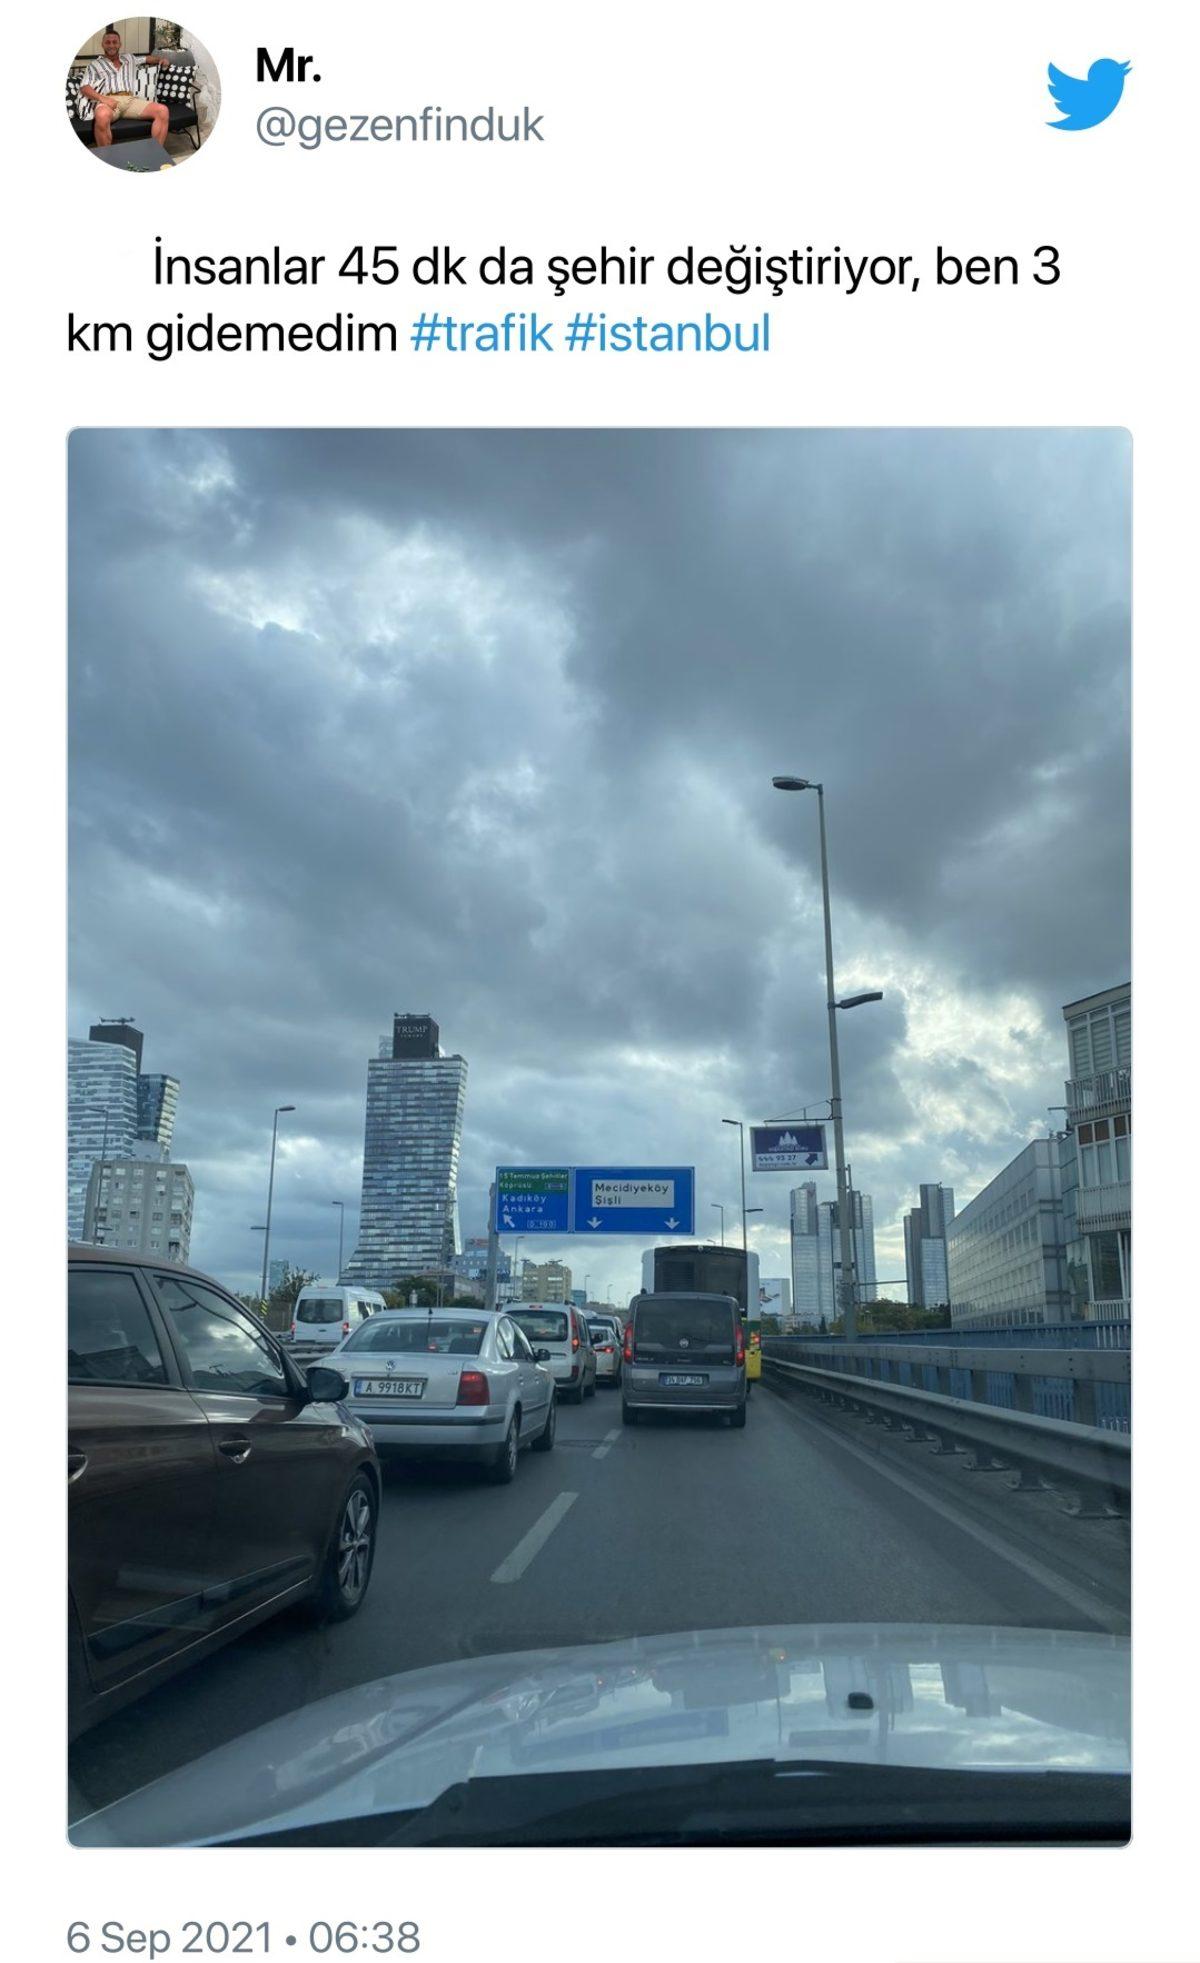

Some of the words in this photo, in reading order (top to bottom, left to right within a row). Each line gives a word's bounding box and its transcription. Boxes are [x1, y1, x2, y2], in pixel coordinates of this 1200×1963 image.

[396, 1025, 428, 1034] TRUMP
[594, 1183, 669, 1195] Mecidiyeköy
[502, 1194, 547, 1205] Kadıköy
[594, 1194, 622, 1206] Şişli
[502, 1205, 544, 1213] Ankara
[365, 1382, 373, 1393] A
